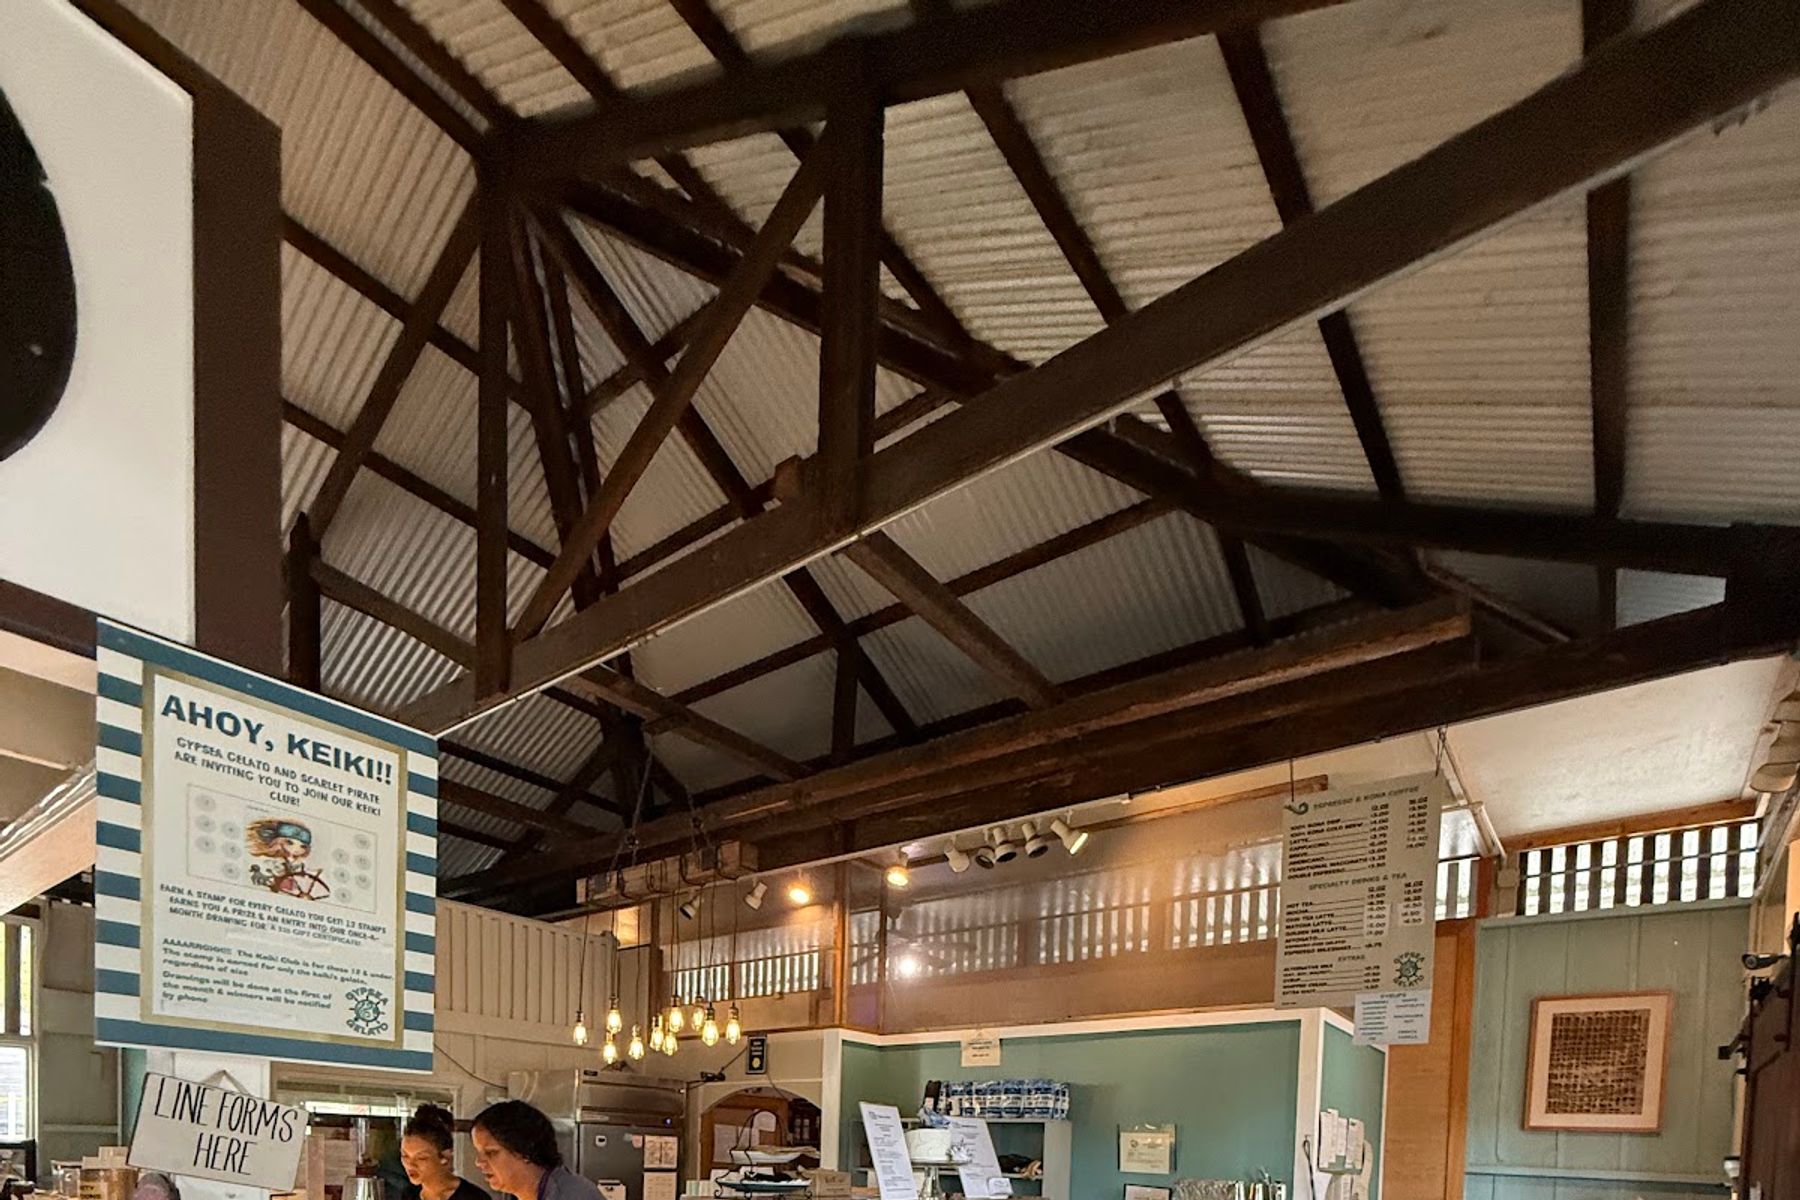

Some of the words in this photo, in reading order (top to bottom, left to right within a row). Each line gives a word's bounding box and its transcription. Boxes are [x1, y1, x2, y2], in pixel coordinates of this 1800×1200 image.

[161, 694, 274, 752] AHOY,
[287, 733, 392, 785] KEIKI!!
[174, 751, 198, 766] ARE
[201, 758, 255, 782] INVITING
[258, 774, 282, 789] YOU
[285, 781, 300, 794] TO
[302, 787, 329, 802] JOIN
[331, 794, 354, 809] OUR
[356, 801, 382, 817] KEIKI
[177, 736, 223, 759] GYPSEA
[226, 751, 271, 772] GELATO
[274, 766, 297, 780] AND
[300, 773, 344, 794] SCARLET
[347, 786, 381, 805] PIRATE
[269, 791, 301, 808] CLUB!
[344, 986, 389, 1006] GYPSEA
[345, 1019, 390, 1036] GELATO
[154, 1077, 215, 1127] LINE
[216, 1091, 299, 1143] FORMS
[193, 1132, 258, 1176] HERE
